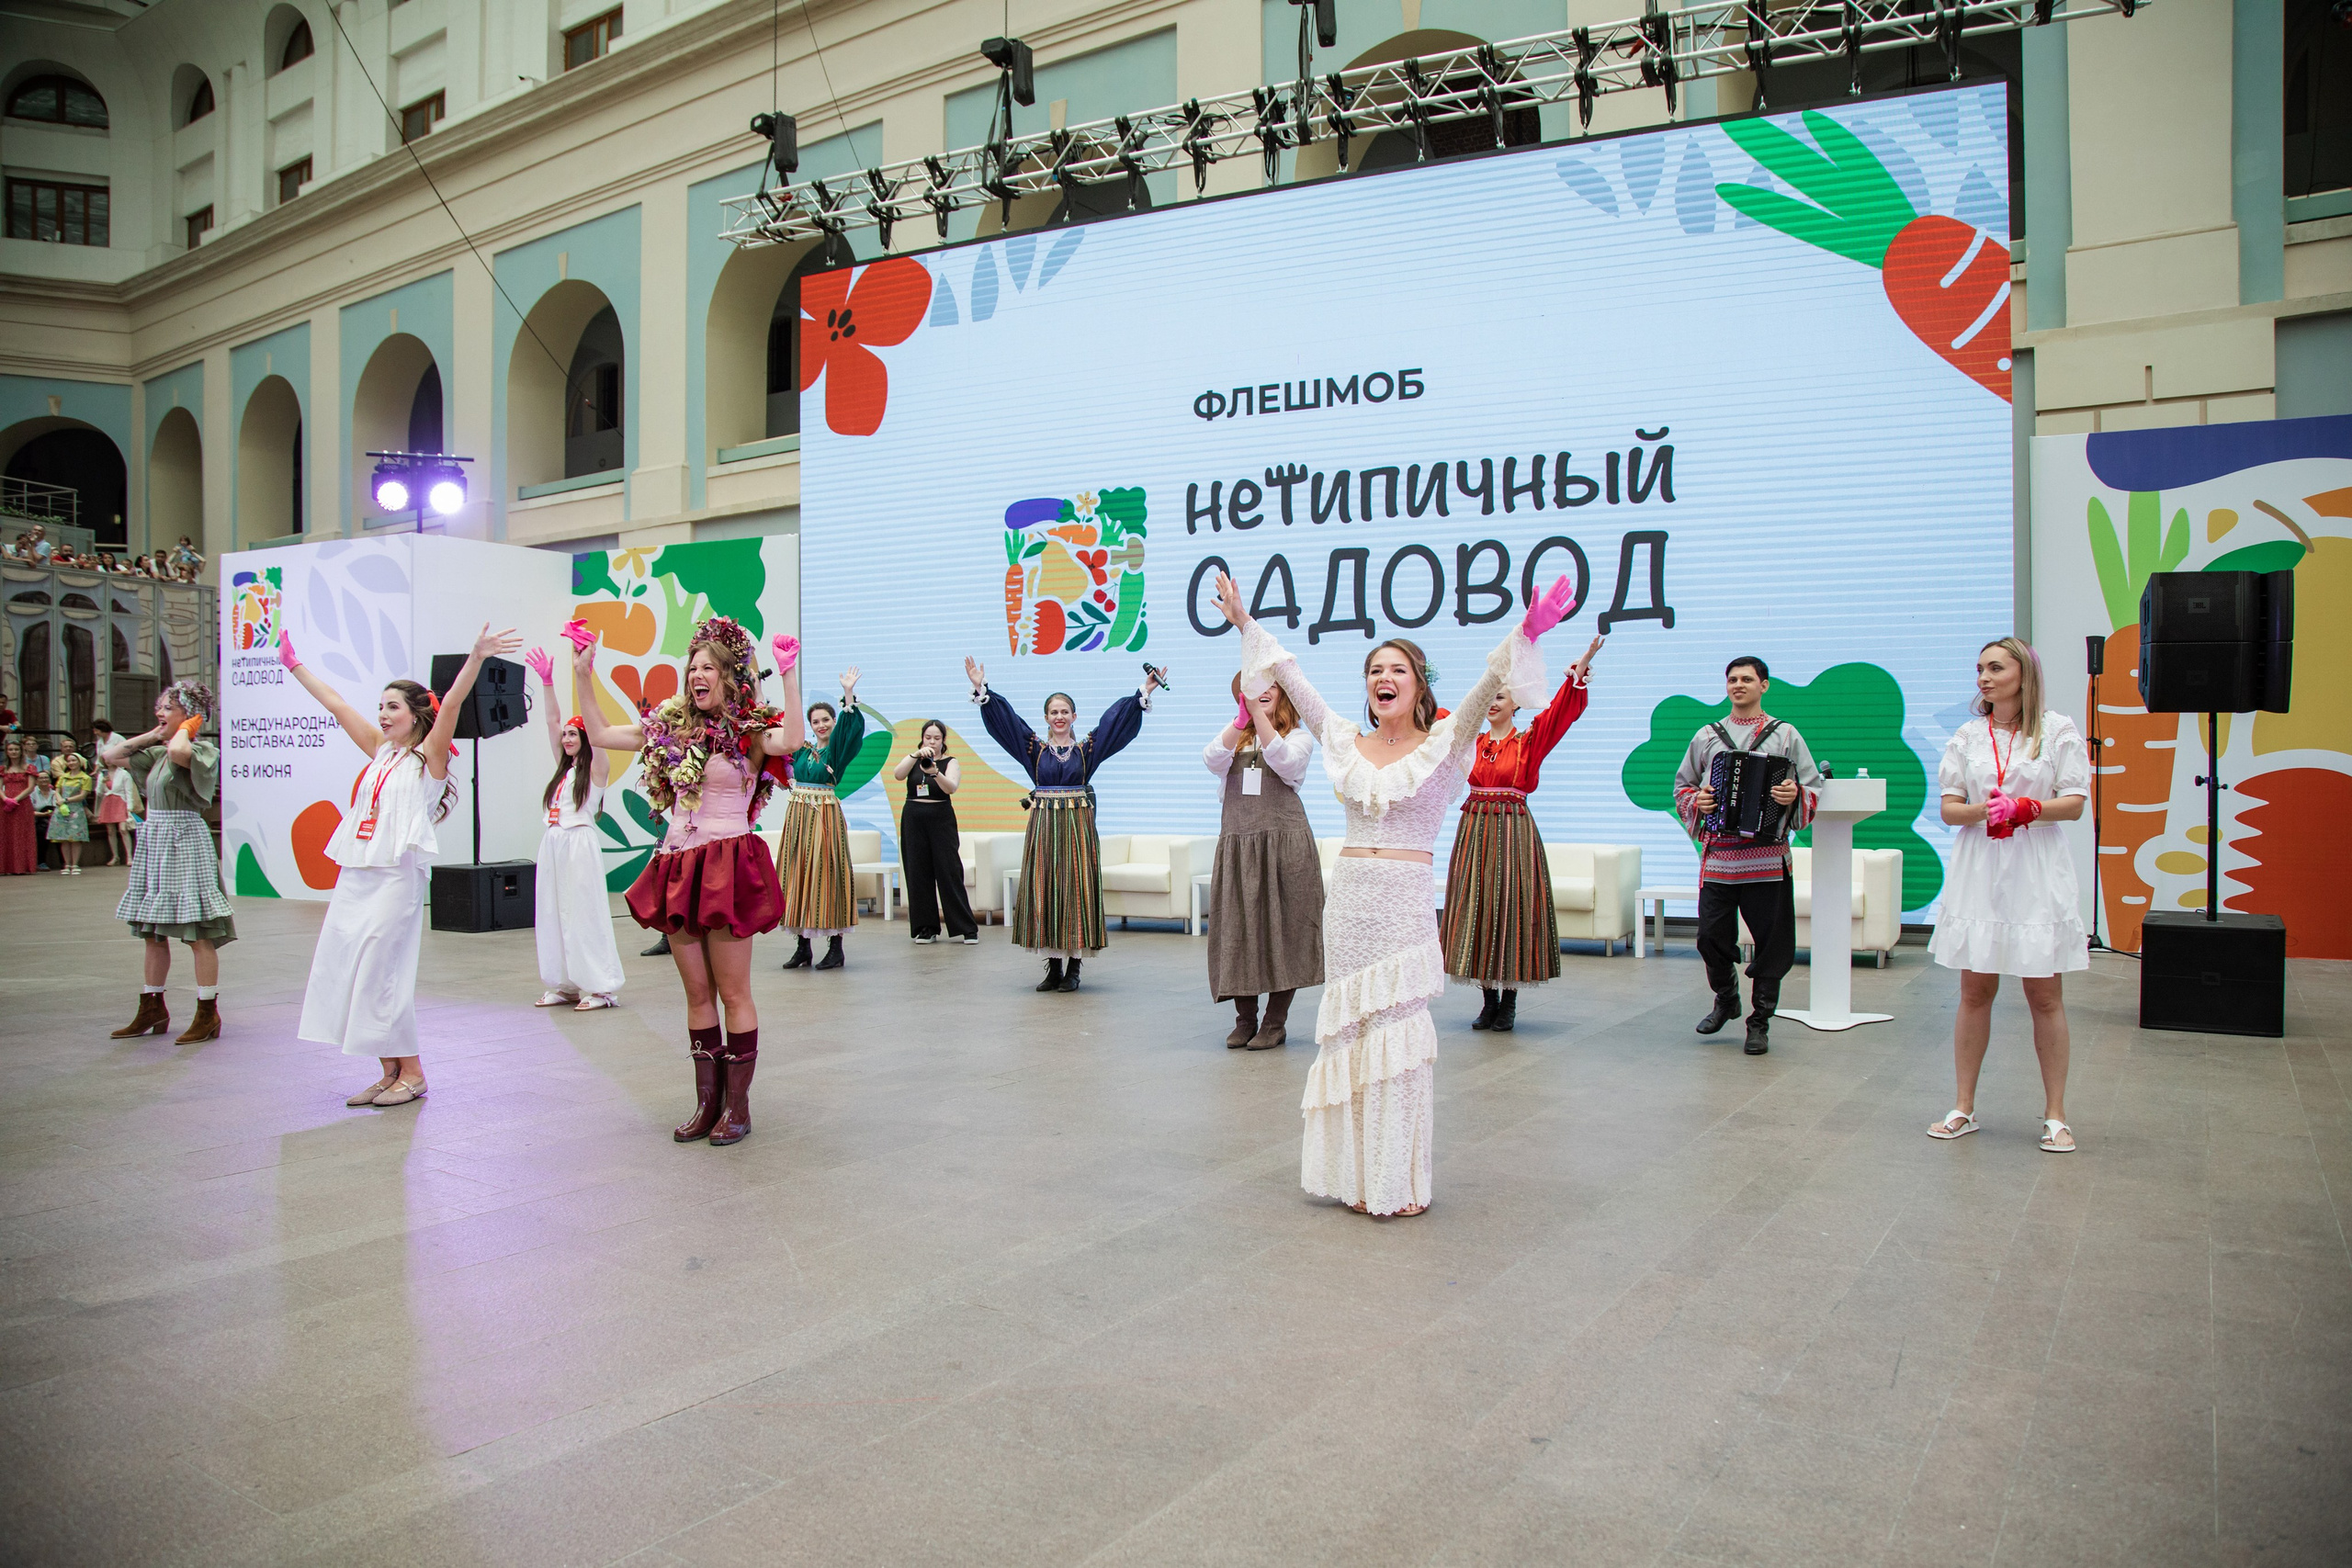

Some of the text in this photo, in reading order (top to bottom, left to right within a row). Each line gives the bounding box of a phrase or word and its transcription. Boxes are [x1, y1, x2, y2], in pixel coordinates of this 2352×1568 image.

[1193, 367, 1425, 421] ФЛЕШМОБ
[1186, 530, 1676, 645] САДОВОД
[232, 669, 283, 686] САДОВОД
[231, 734, 324, 749] ВЫСТАВКА 2025
[231, 764, 291, 778] 6-8 ИЮНЯ
[1730, 759, 1742, 807] HOHNER
